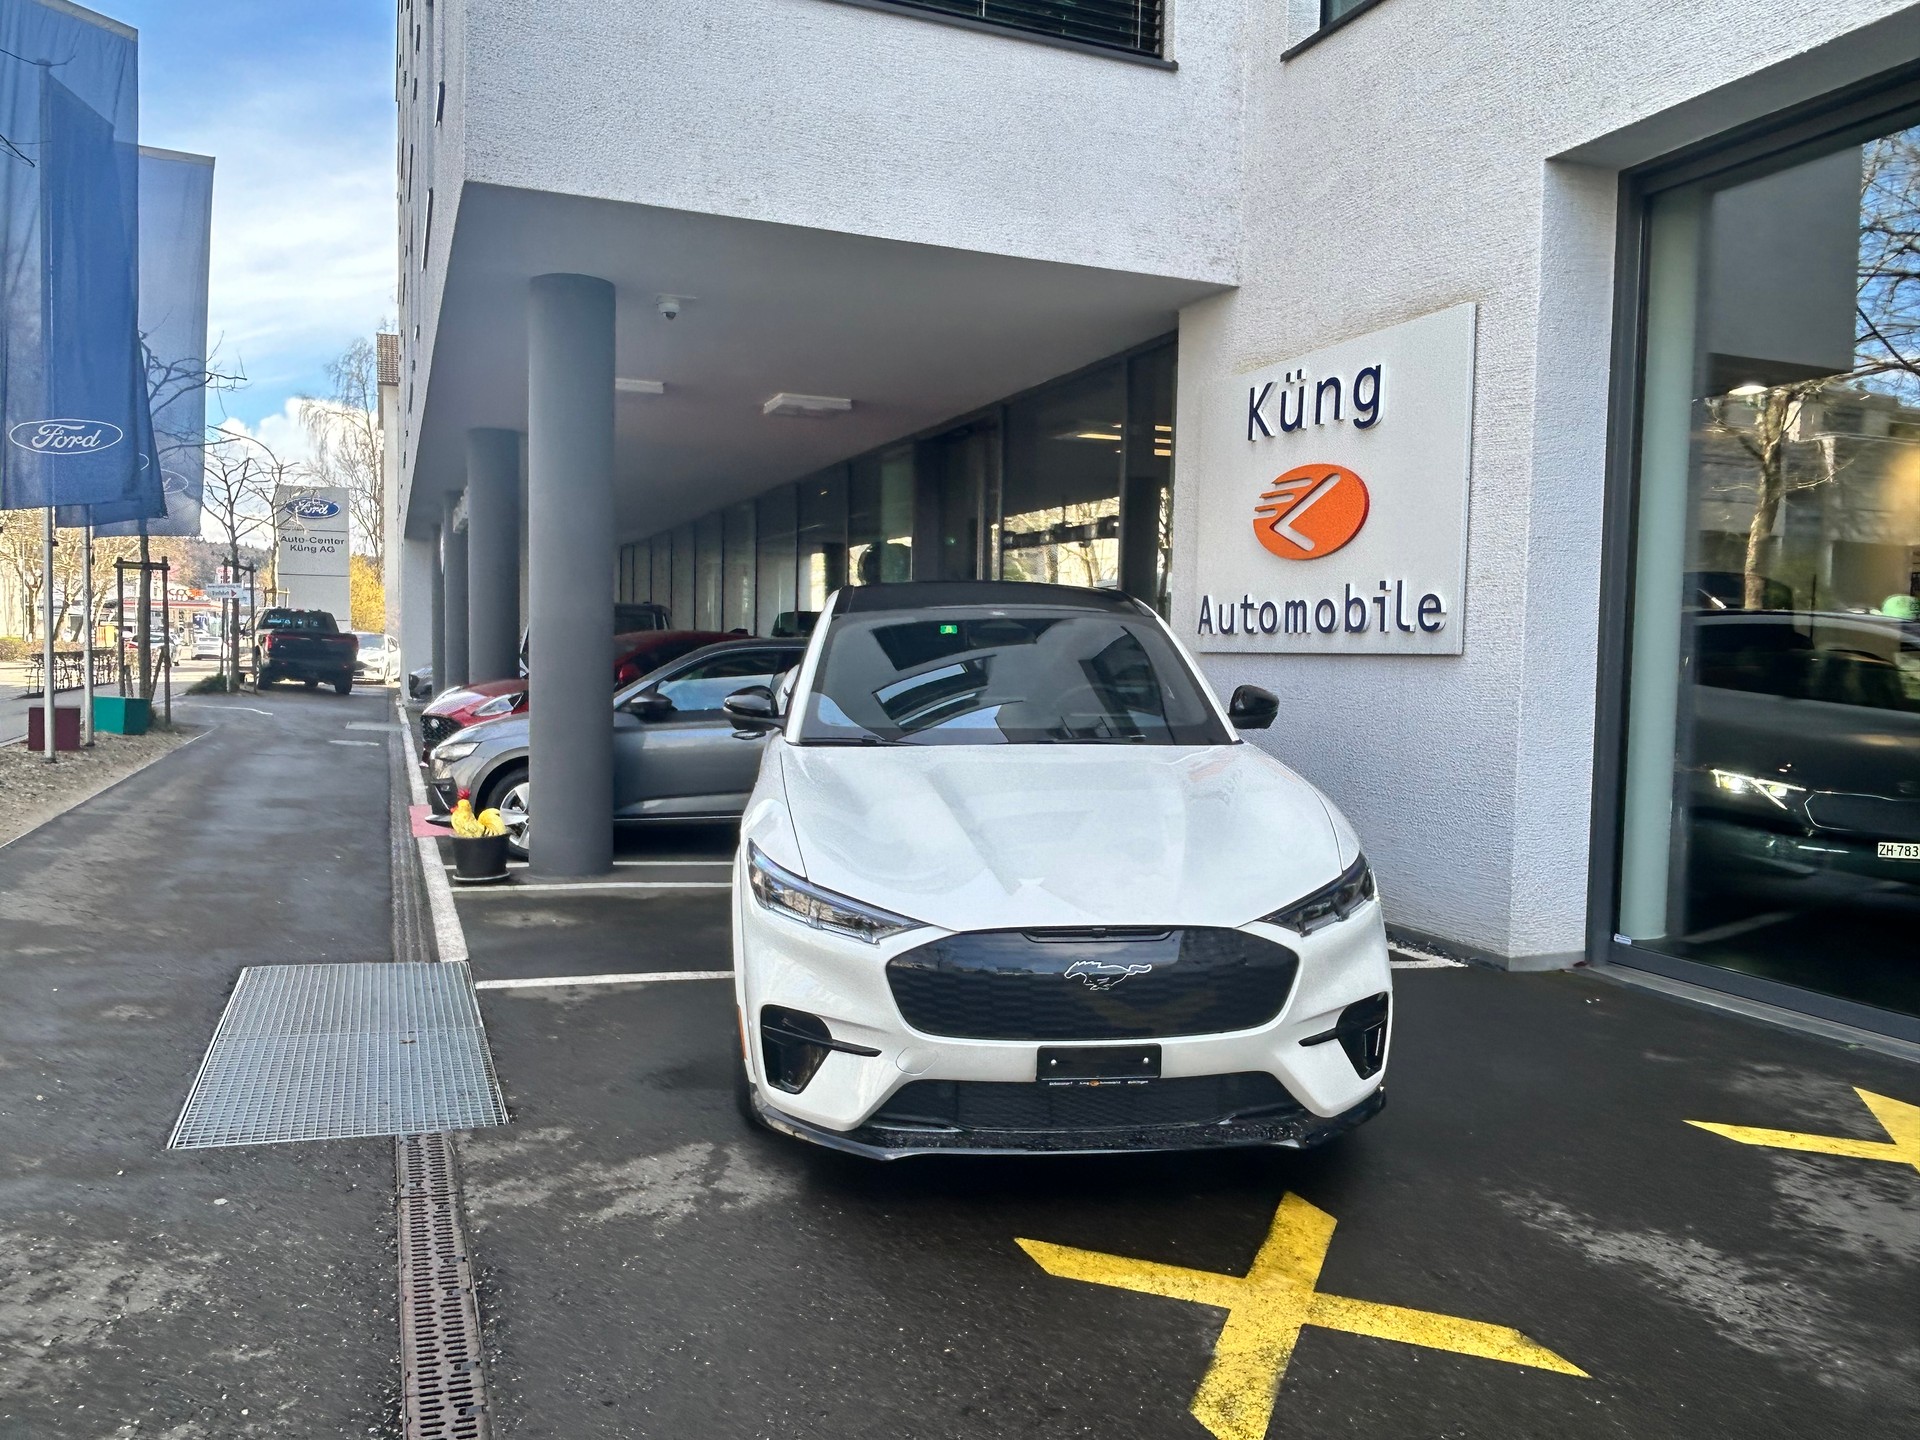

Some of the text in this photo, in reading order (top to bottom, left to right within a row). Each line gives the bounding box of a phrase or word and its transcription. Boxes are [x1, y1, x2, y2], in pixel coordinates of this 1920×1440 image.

[1247, 364, 1386, 442] Küng
[31, 423, 102, 449] Ford
[294, 499, 329, 515] Ford
[290, 544, 336, 554] Küng AG
[1197, 579, 1447, 636] Automobile
